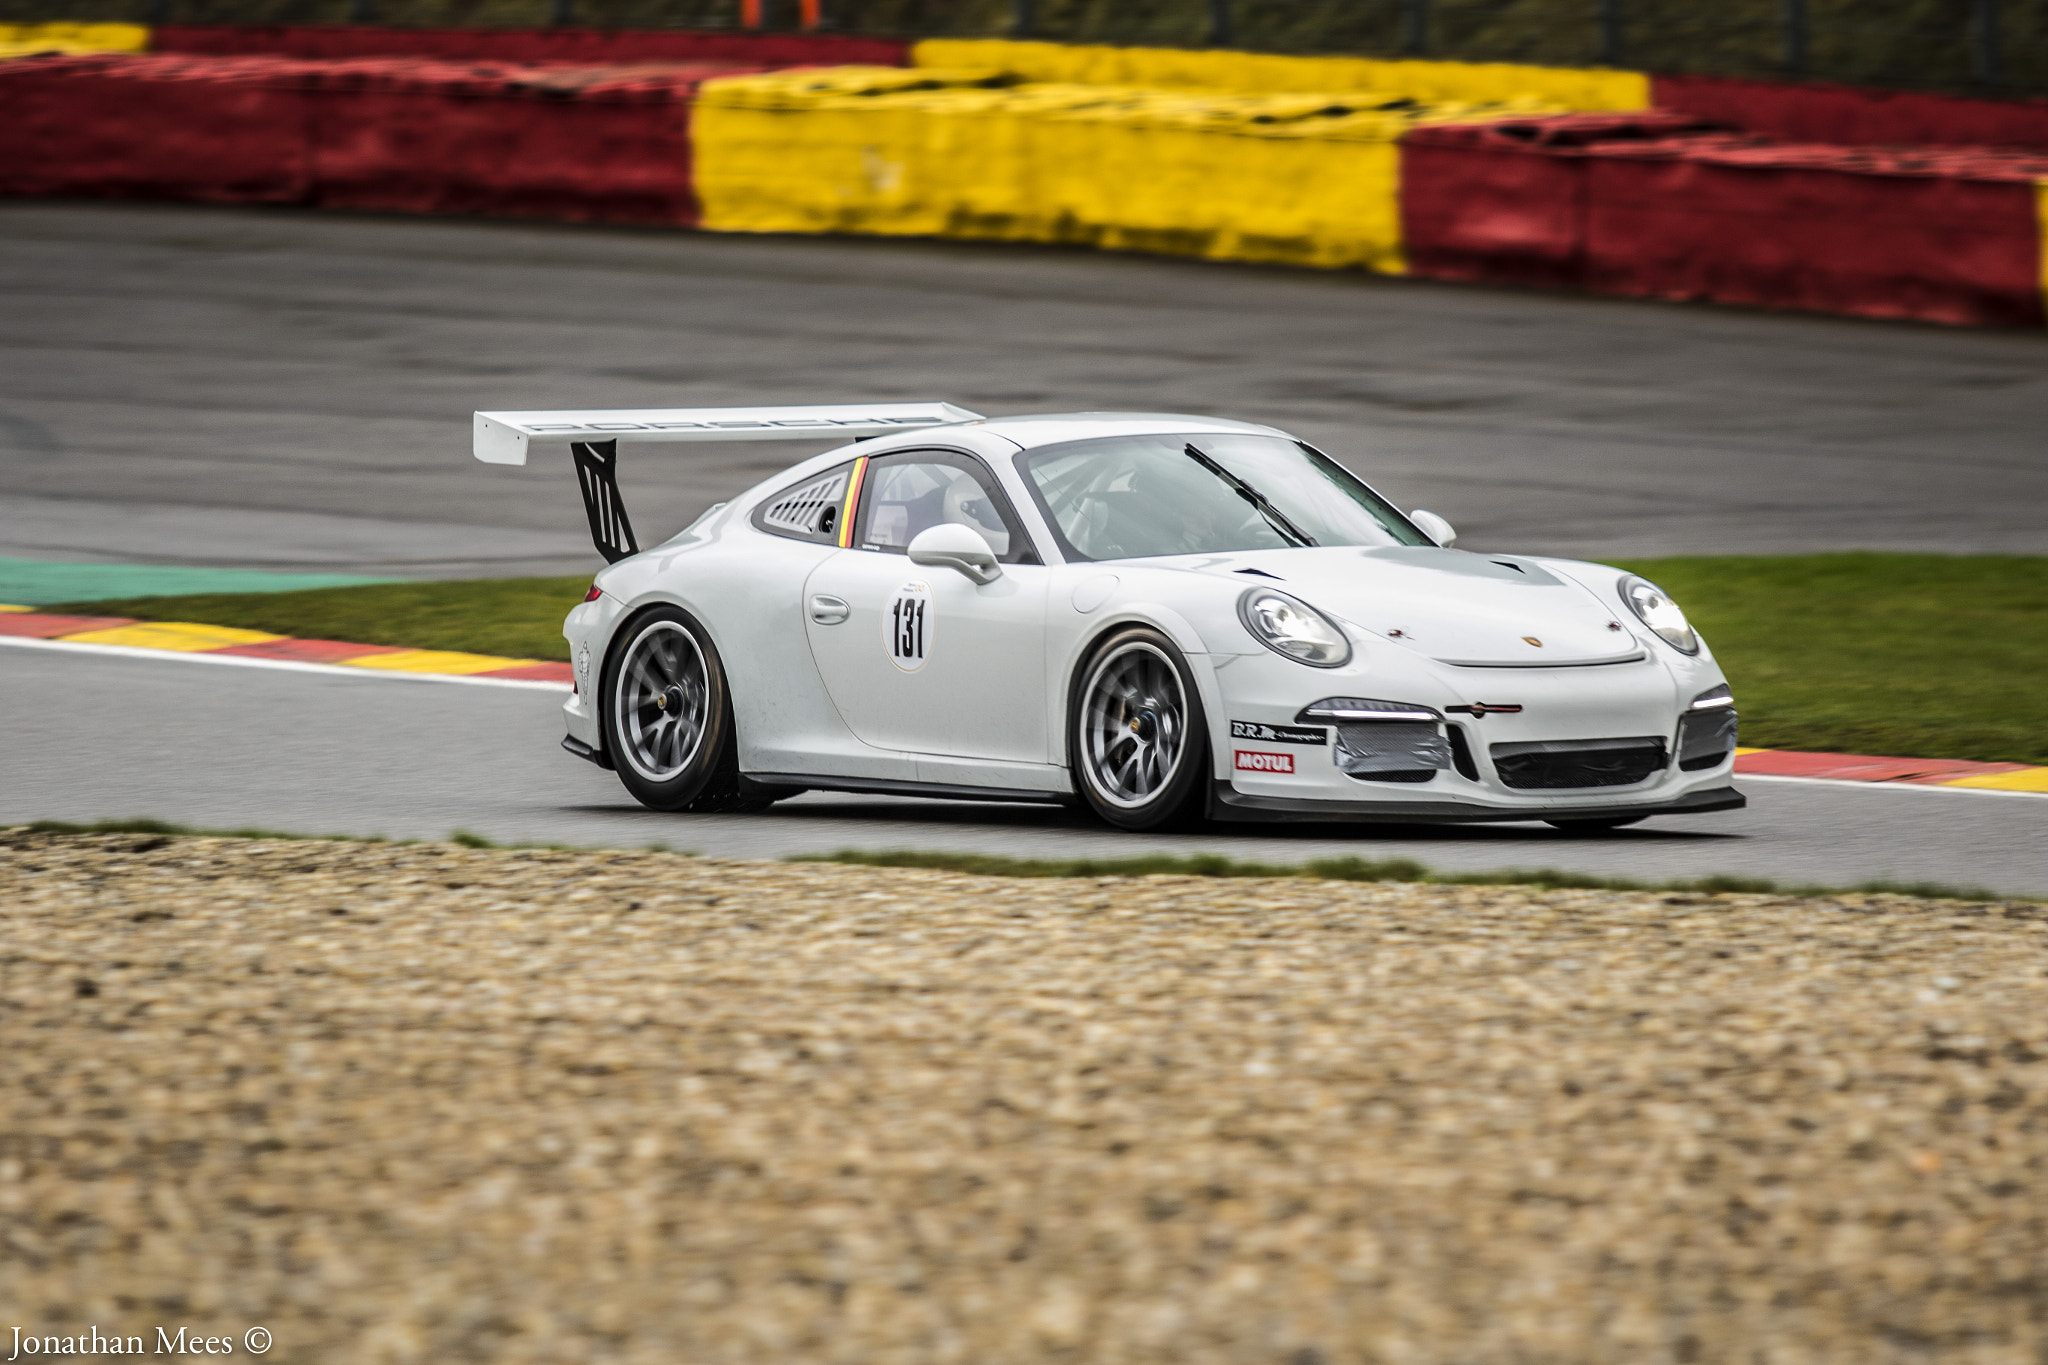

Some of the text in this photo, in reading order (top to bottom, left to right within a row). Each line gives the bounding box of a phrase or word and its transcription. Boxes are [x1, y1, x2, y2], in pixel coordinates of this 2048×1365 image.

[520, 416, 942, 431] PORSCHE
[893, 597, 926, 659] 131
[1237, 752, 1292, 772] MOTUL
